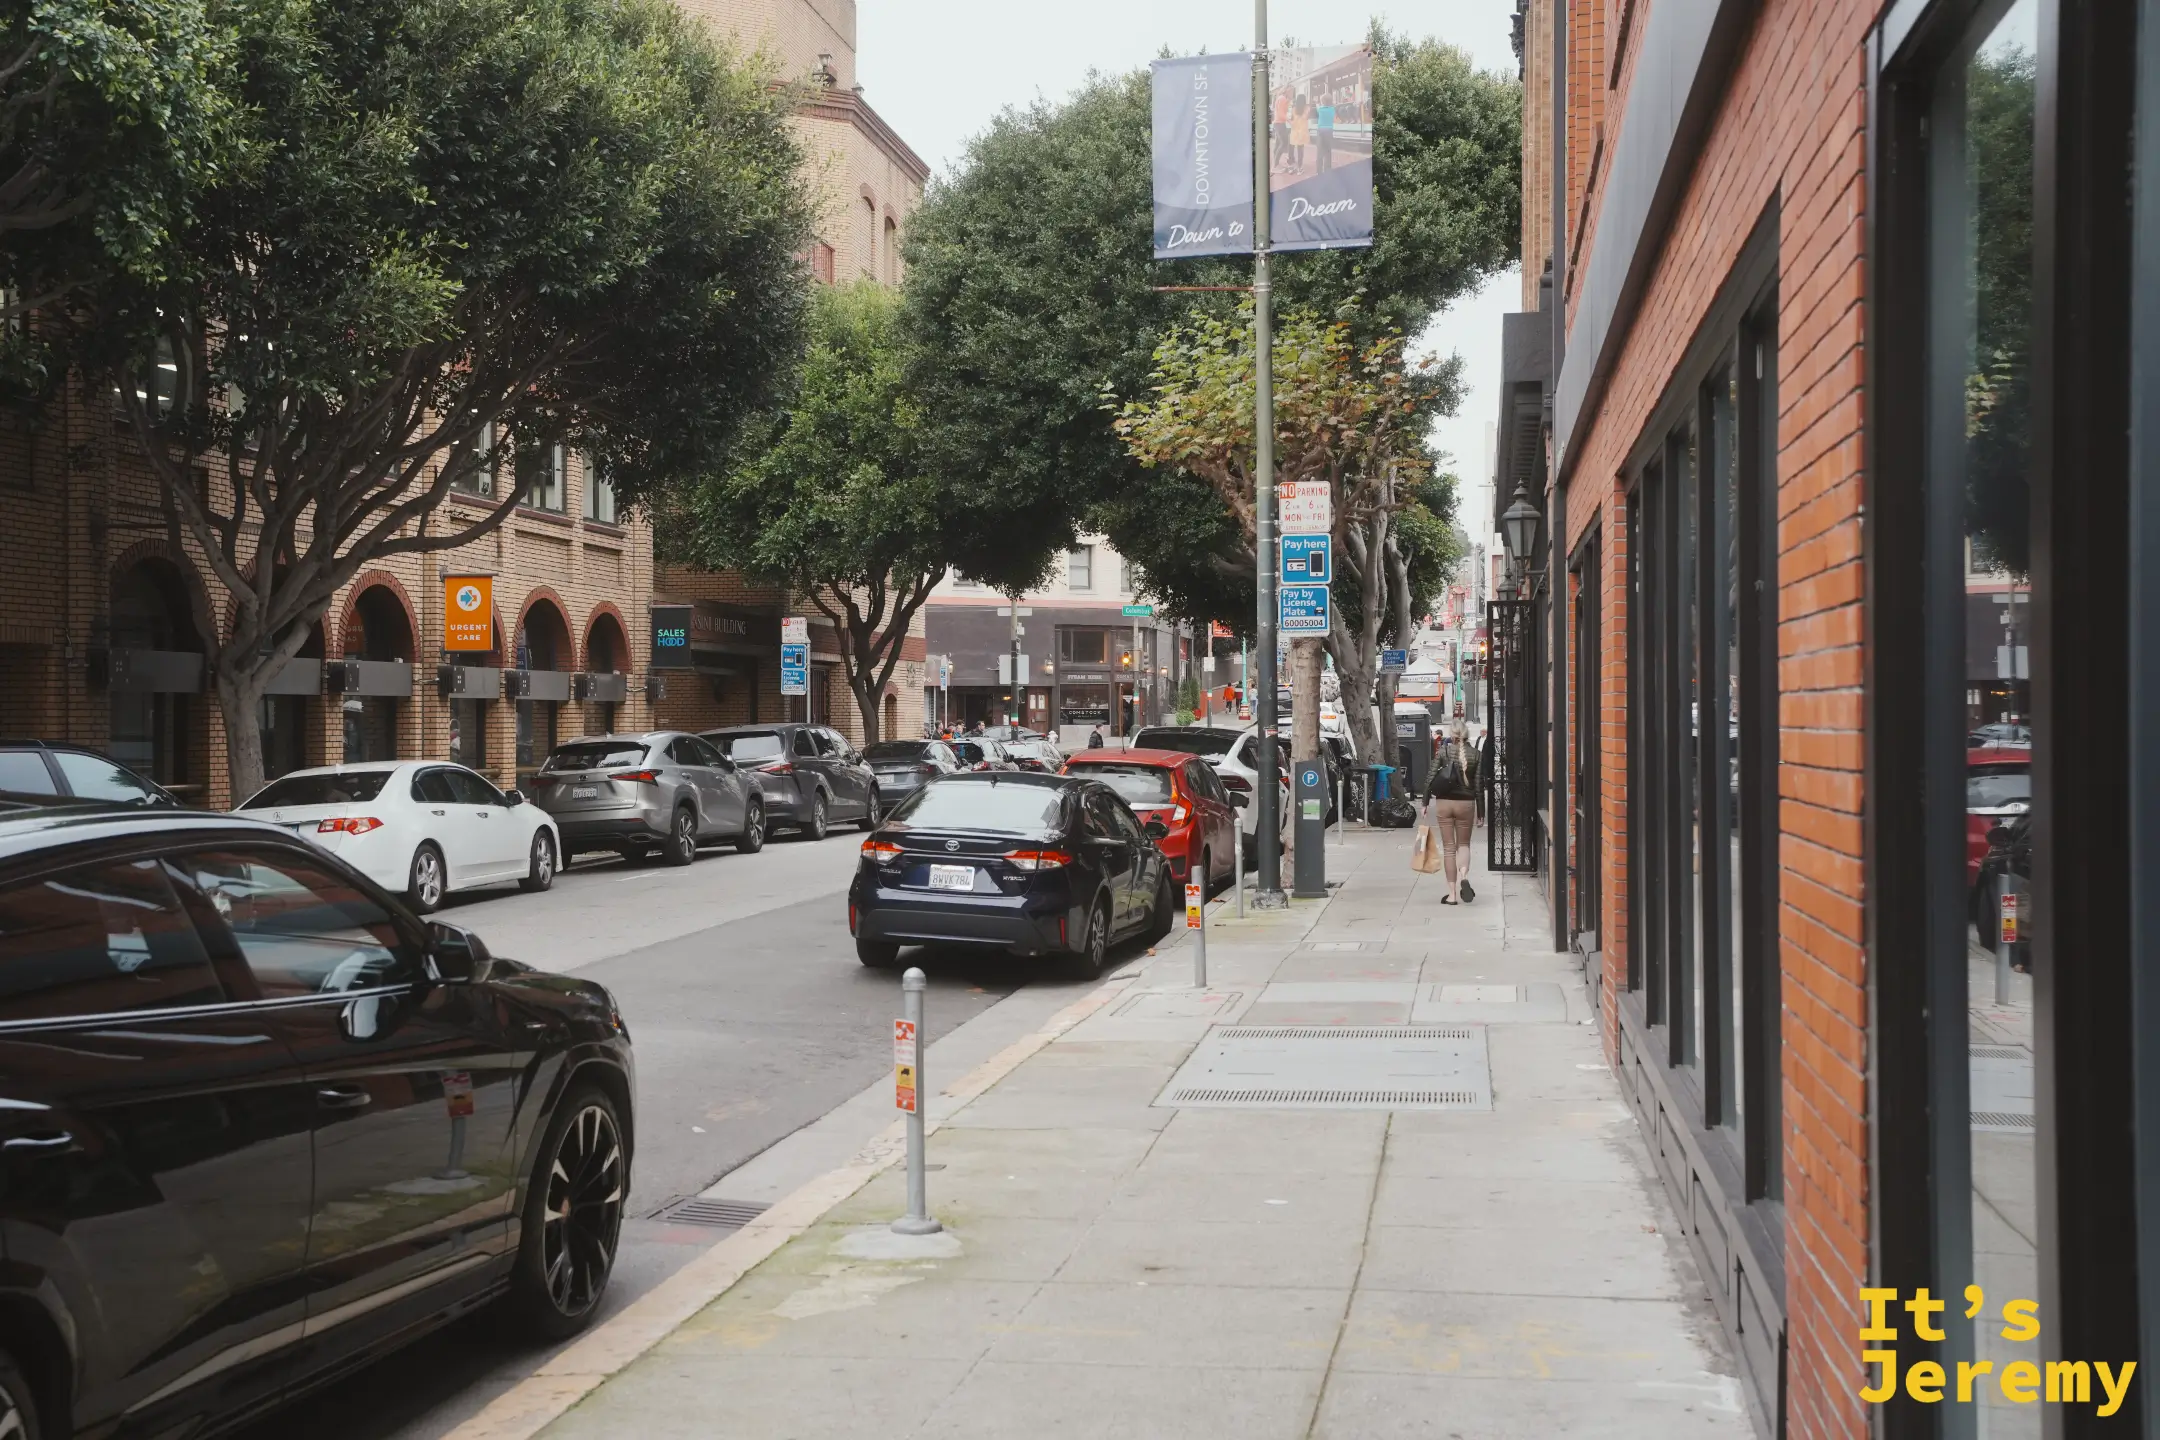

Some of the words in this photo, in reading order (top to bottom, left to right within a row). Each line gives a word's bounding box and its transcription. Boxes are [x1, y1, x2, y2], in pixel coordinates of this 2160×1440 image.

[1194, 73, 1208, 90] SF
[1195, 96, 1209, 205] DOWNTOWN
[1287, 197, 1357, 222] Dream
[1167, 224, 1223, 248] Down
[1228, 220, 1244, 236] to
[1281, 484, 1295, 498] NO
[1297, 487, 1328, 497] PARKING
[1285, 500, 1291, 510] 2
[1312, 513, 1325, 521] FRI
[1284, 540, 1302, 551] Pay
[1304, 539, 1327, 549] here
[1283, 589, 1299, 600] Pay
[1301, 589, 1314, 600] by
[1283, 607, 1306, 616] Plate
[714, 617, 747, 635] BUILDING
[1284, 619, 1324, 627] 60005004
[657, 629, 685, 637] SALES
[657, 637, 685, 647] HOOD
[783, 646, 792, 654] Pay
[1307, 773, 1315, 783] P
[932, 873, 970, 885] 8WVK784
